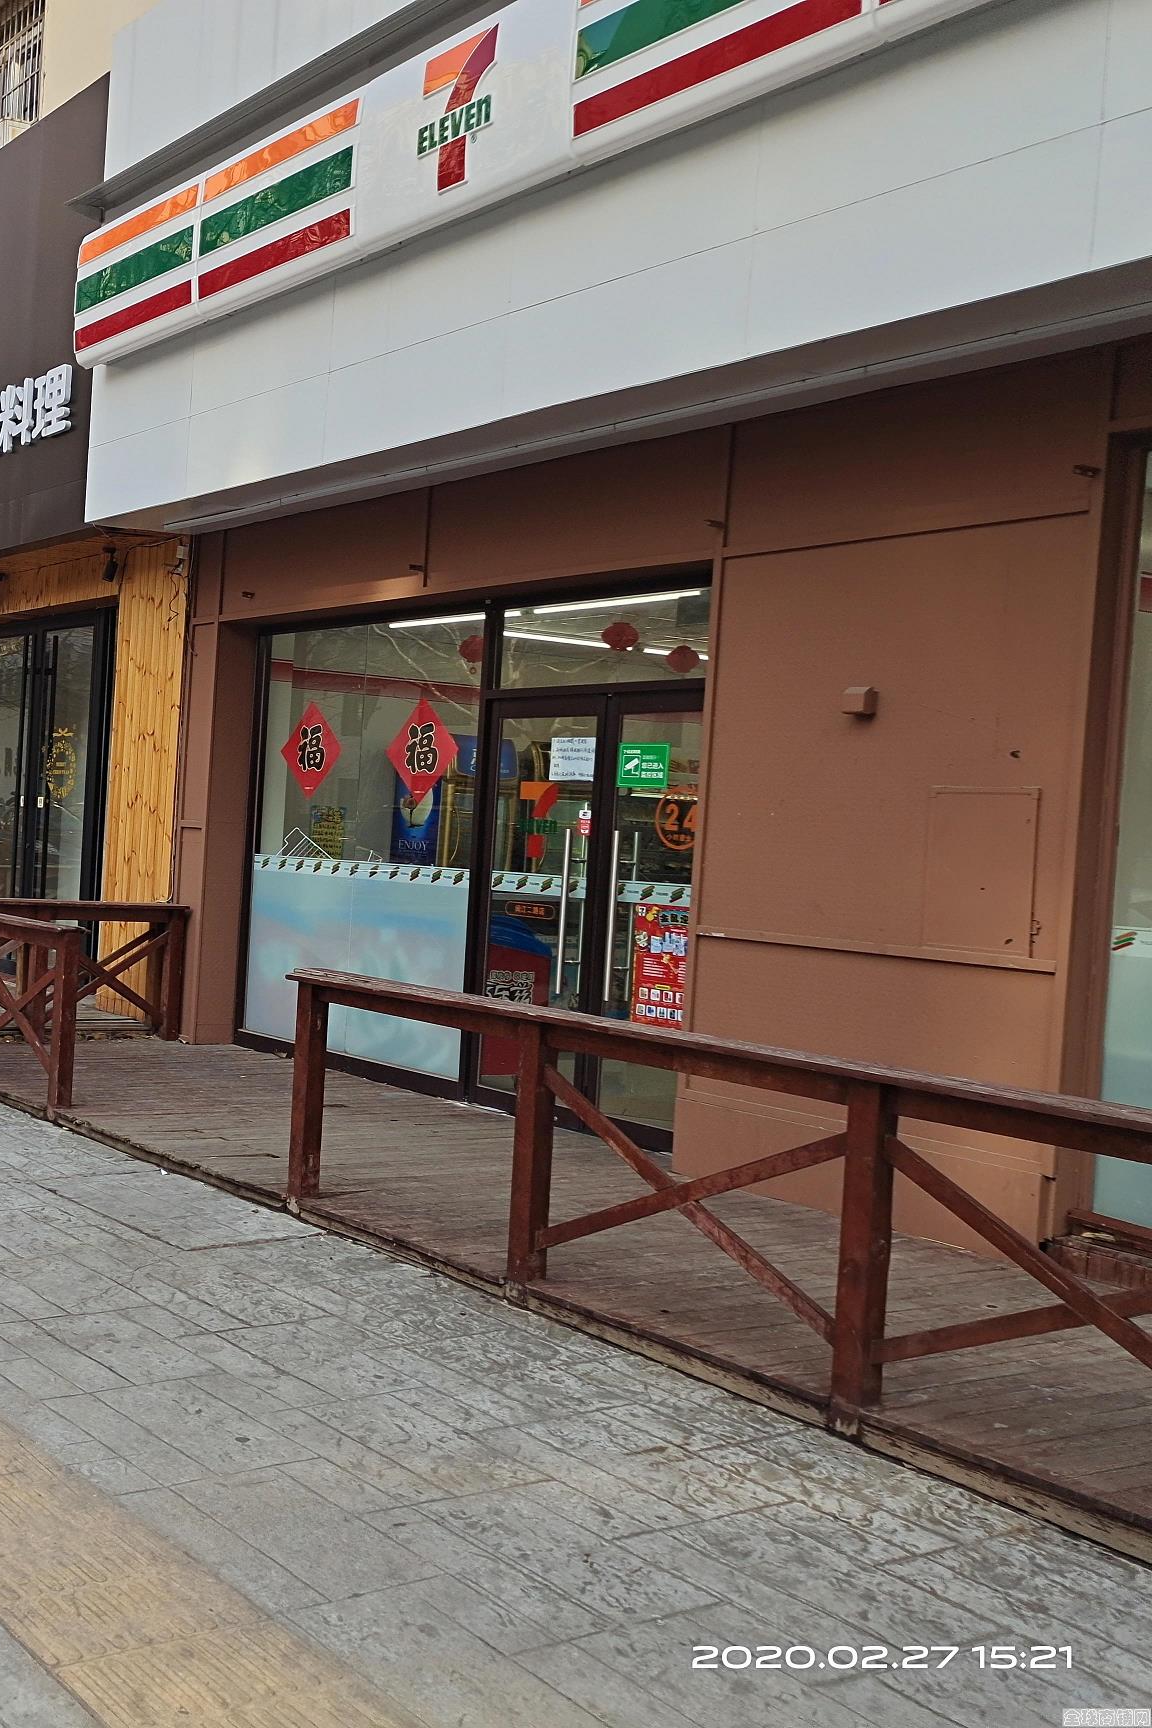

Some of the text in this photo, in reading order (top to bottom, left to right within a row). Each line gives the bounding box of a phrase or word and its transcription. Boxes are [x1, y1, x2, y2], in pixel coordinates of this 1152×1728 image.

[423, 23, 499, 192] 7
[297, 723, 326, 772] 福
[404, 722, 439, 774] 福
[666, 803, 698, 833] 24
[398, 839, 428, 851] ENJOY
